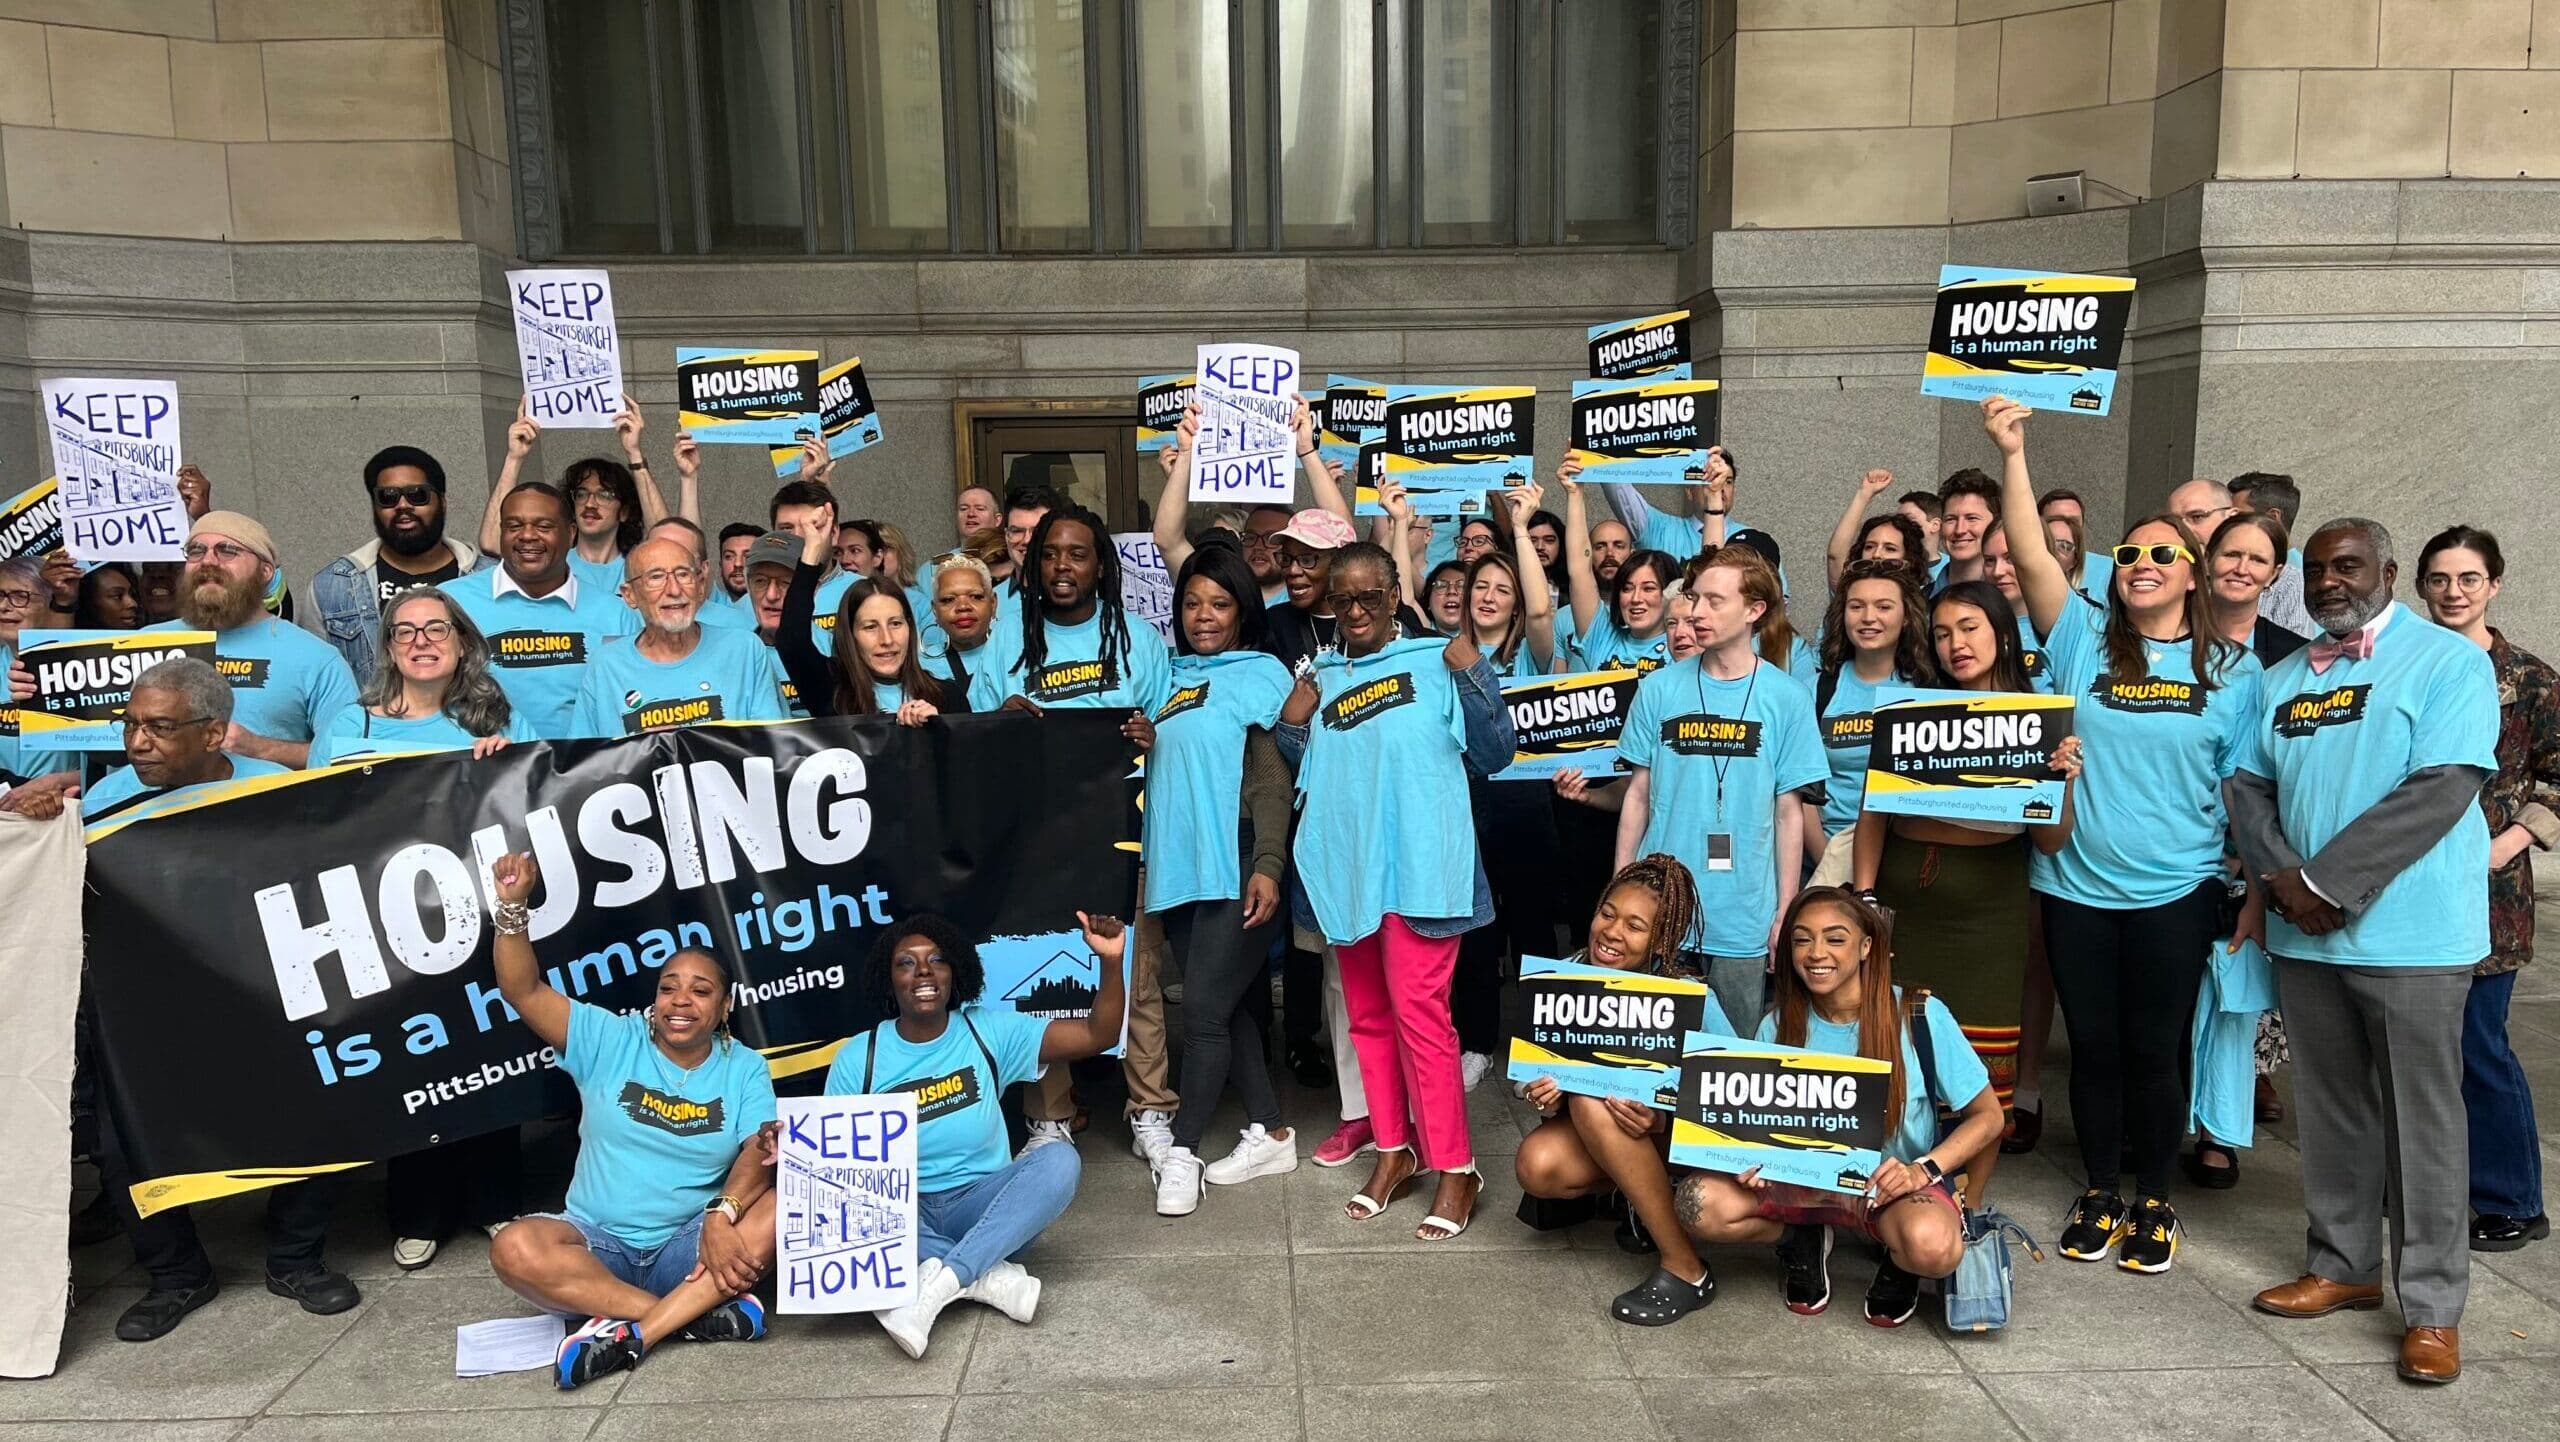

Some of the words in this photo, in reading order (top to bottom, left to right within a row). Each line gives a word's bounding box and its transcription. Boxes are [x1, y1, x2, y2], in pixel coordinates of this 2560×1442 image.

[518, 282, 604, 321] KEEP
[1950, 296, 2099, 337] HOUSING
[555, 324, 612, 353] PITTSBURGH
[1598, 324, 1676, 366] HOUSING
[1951, 340, 1964, 354] is
[1968, 343, 1977, 353] a
[1982, 338, 2044, 353] human
[2050, 335, 2097, 353] right
[1205, 356, 1293, 396] KEEP
[1601, 367, 1609, 376] is
[1611, 366, 1617, 374] a
[1619, 357, 1654, 371] human
[1655, 347, 1678, 361] right
[692, 364, 799, 399] HOUSING
[532, 380, 617, 418] HOME
[697, 400, 707, 411] is
[710, 400, 718, 409] a
[722, 395, 768, 409] human
[771, 391, 804, 407] right
[837, 398, 861, 418] right
[1239, 396, 1293, 427] PITTSBURGH
[55, 393, 170, 439] KEEP
[1401, 402, 1513, 441] HOUSING
[1585, 395, 1695, 436] HOUSING
[1404, 442, 1415, 454] is
[1418, 442, 1427, 452] a
[1430, 436, 1478, 452] human
[1481, 431, 1516, 448] right
[1588, 436, 1599, 449] is
[1602, 437, 1609, 447] a
[1613, 432, 1660, 446] human
[1664, 425, 1698, 441] right
[105, 440, 174, 475] PITTSBURGH
[1200, 455, 1285, 492] HOME
[75, 507, 181, 549] HOME
[501, 635, 571, 653] HOUSING
[503, 653, 511, 661] is
[520, 652, 551, 660] human
[552, 651, 573, 660] right
[1041, 664, 1103, 689] HOUSING
[1059, 682, 1086, 693] human
[1088, 679, 1108, 689] rigt
[2113, 683, 2191, 699] HOUSING
[45, 696, 61, 711] is
[64, 697, 76, 708] a
[1338, 678, 1400, 717] HOUSING
[2128, 698, 2163, 708] human
[2165, 698, 2190, 710] right
[640, 700, 710, 728] HOUSING
[1519, 735, 1528, 745] a
[1530, 724, 1582, 743] human
[1585, 716, 1623, 739] right
[1678, 722, 1746, 740] HOUSING
[1891, 712, 2042, 755] HOUSING
[1894, 757, 1908, 772] is
[1913, 759, 1923, 770] a
[1928, 755, 1993, 769] human
[1998, 751, 2045, 769] right
[254, 748, 871, 1021] HOUSING
[305, 1030, 382, 1086] is
[400, 1013, 449, 1055] a
[735, 884, 894, 952] right
[1533, 992, 1676, 1030] HOUSING
[1534, 1028, 1547, 1043] is
[1551, 1032, 1561, 1043] a
[1565, 1029, 1626, 1047] human
[1631, 1034, 1676, 1051] right
[946, 1092, 969, 1105] right
[1700, 1070, 1857, 1109] HOUSING
[641, 1092, 708, 1120] HOUSING
[1701, 1108, 1717, 1124] is
[1722, 1112, 1733, 1124] a
[1738, 1109, 1806, 1127] human
[1811, 1113, 1859, 1131] right
[789, 1110, 908, 1162] KEEP
[836, 1167, 910, 1203] PITTSBURGH
[789, 1242, 906, 1300] HOME
